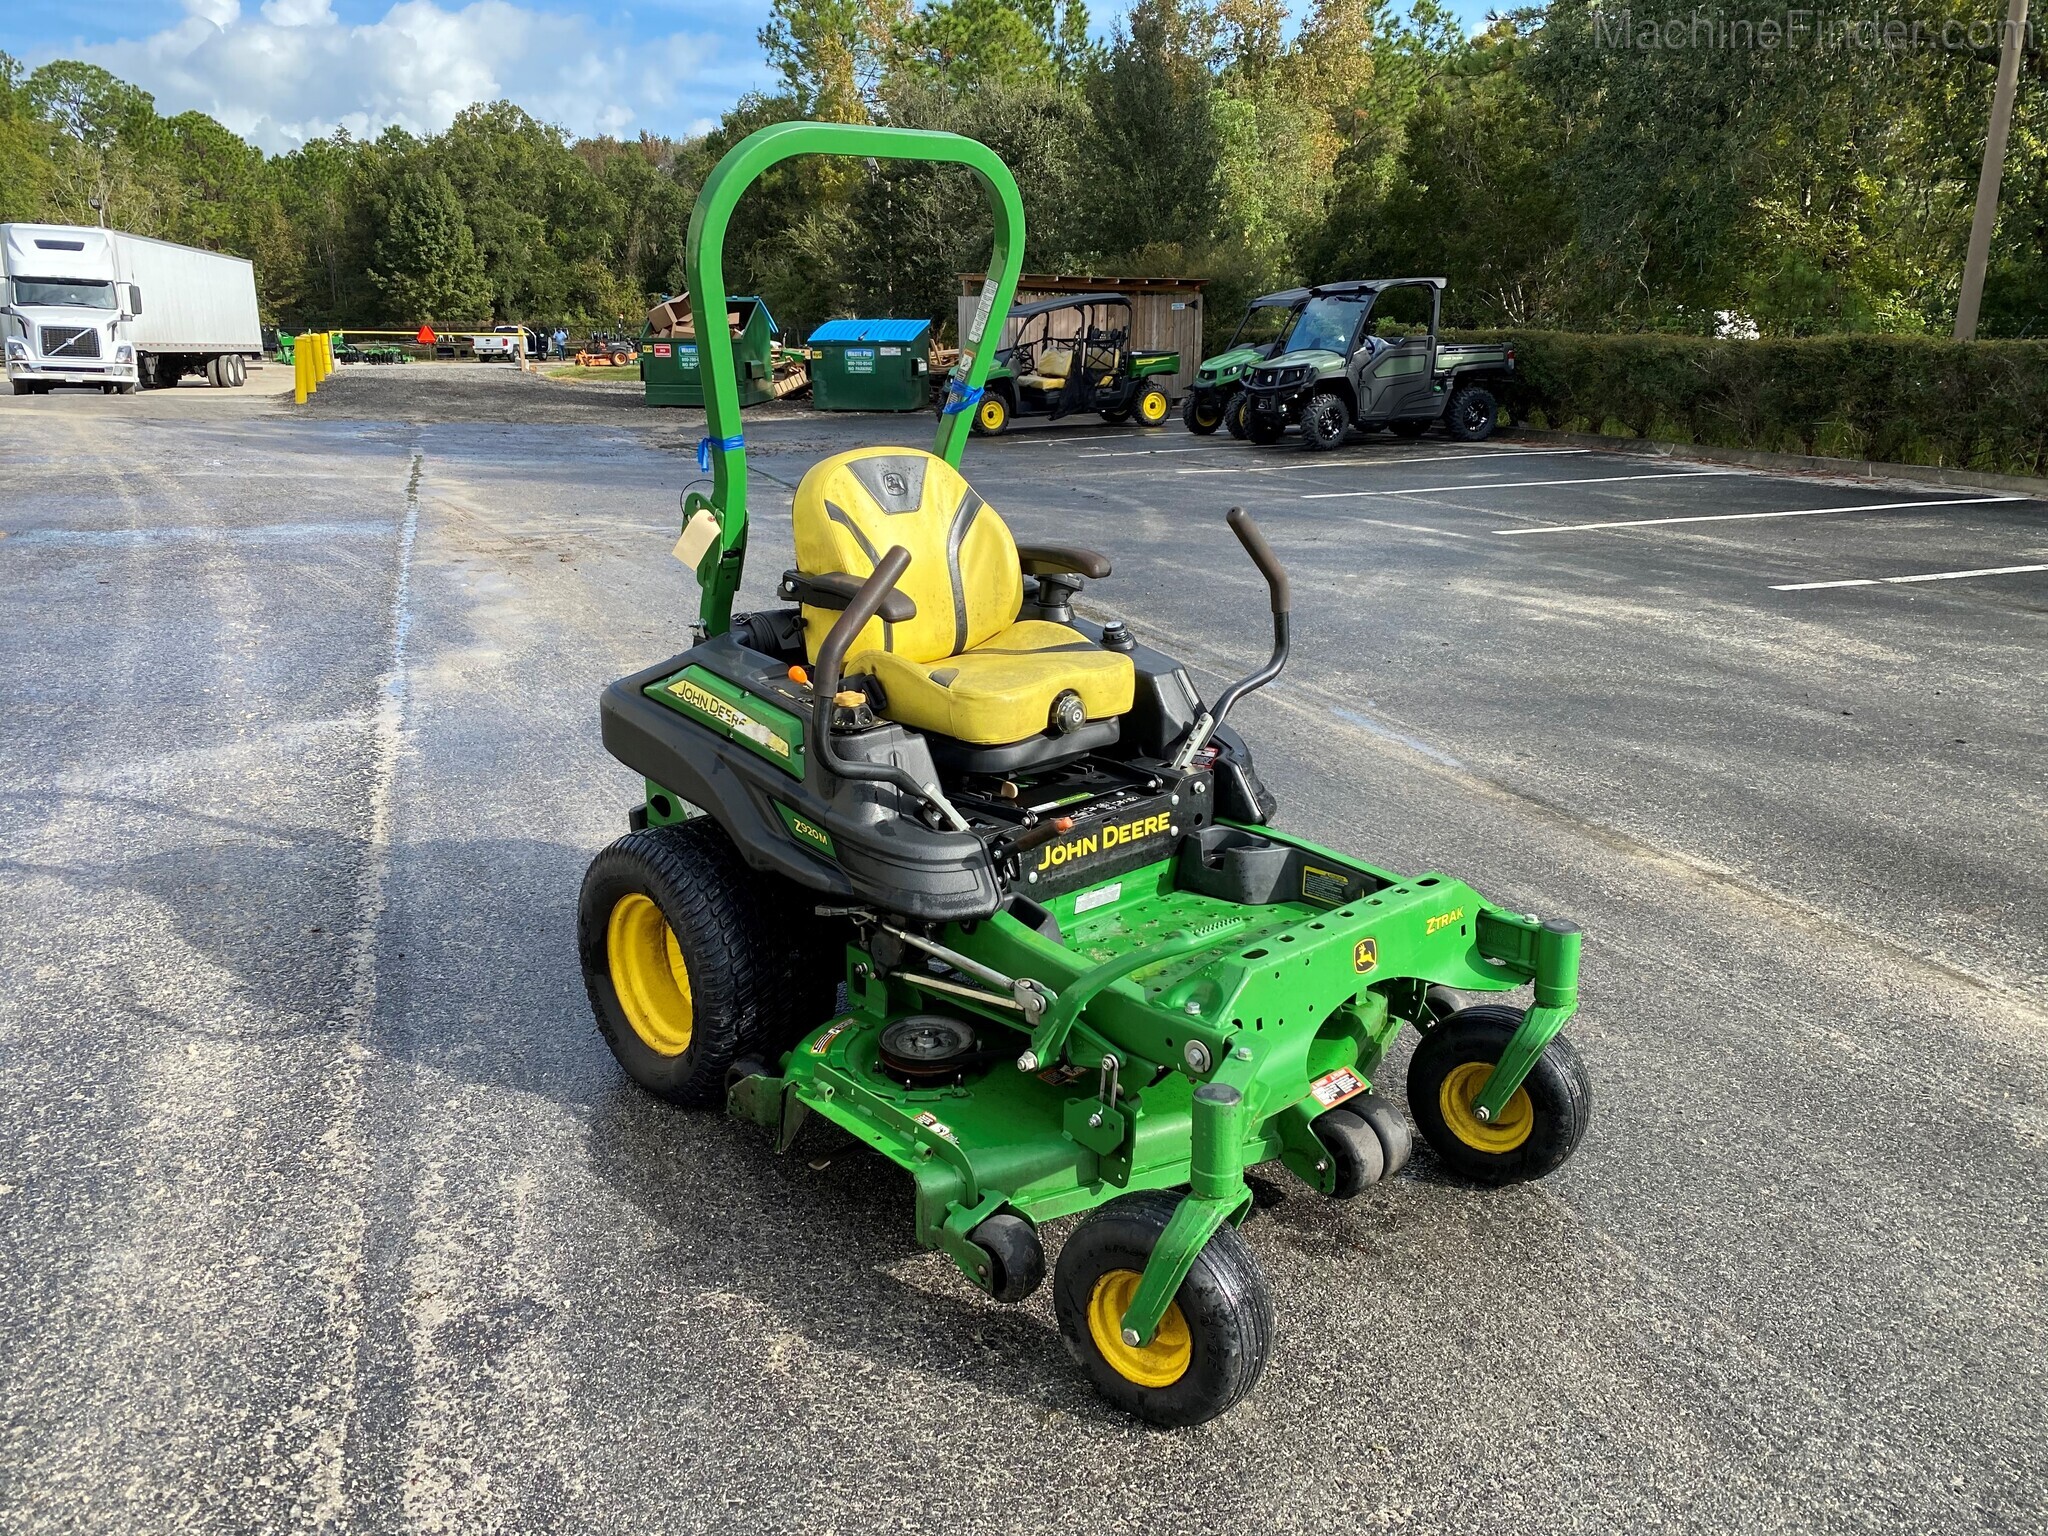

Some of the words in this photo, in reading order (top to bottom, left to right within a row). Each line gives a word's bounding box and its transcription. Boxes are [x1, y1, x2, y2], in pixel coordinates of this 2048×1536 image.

[678, 682, 709, 710] JOHN
[794, 818, 828, 845] Z920M
[1038, 834, 1098, 871] JOHN
[1103, 811, 1171, 850] DEERE
[1426, 906, 1464, 936] ZTRAK
